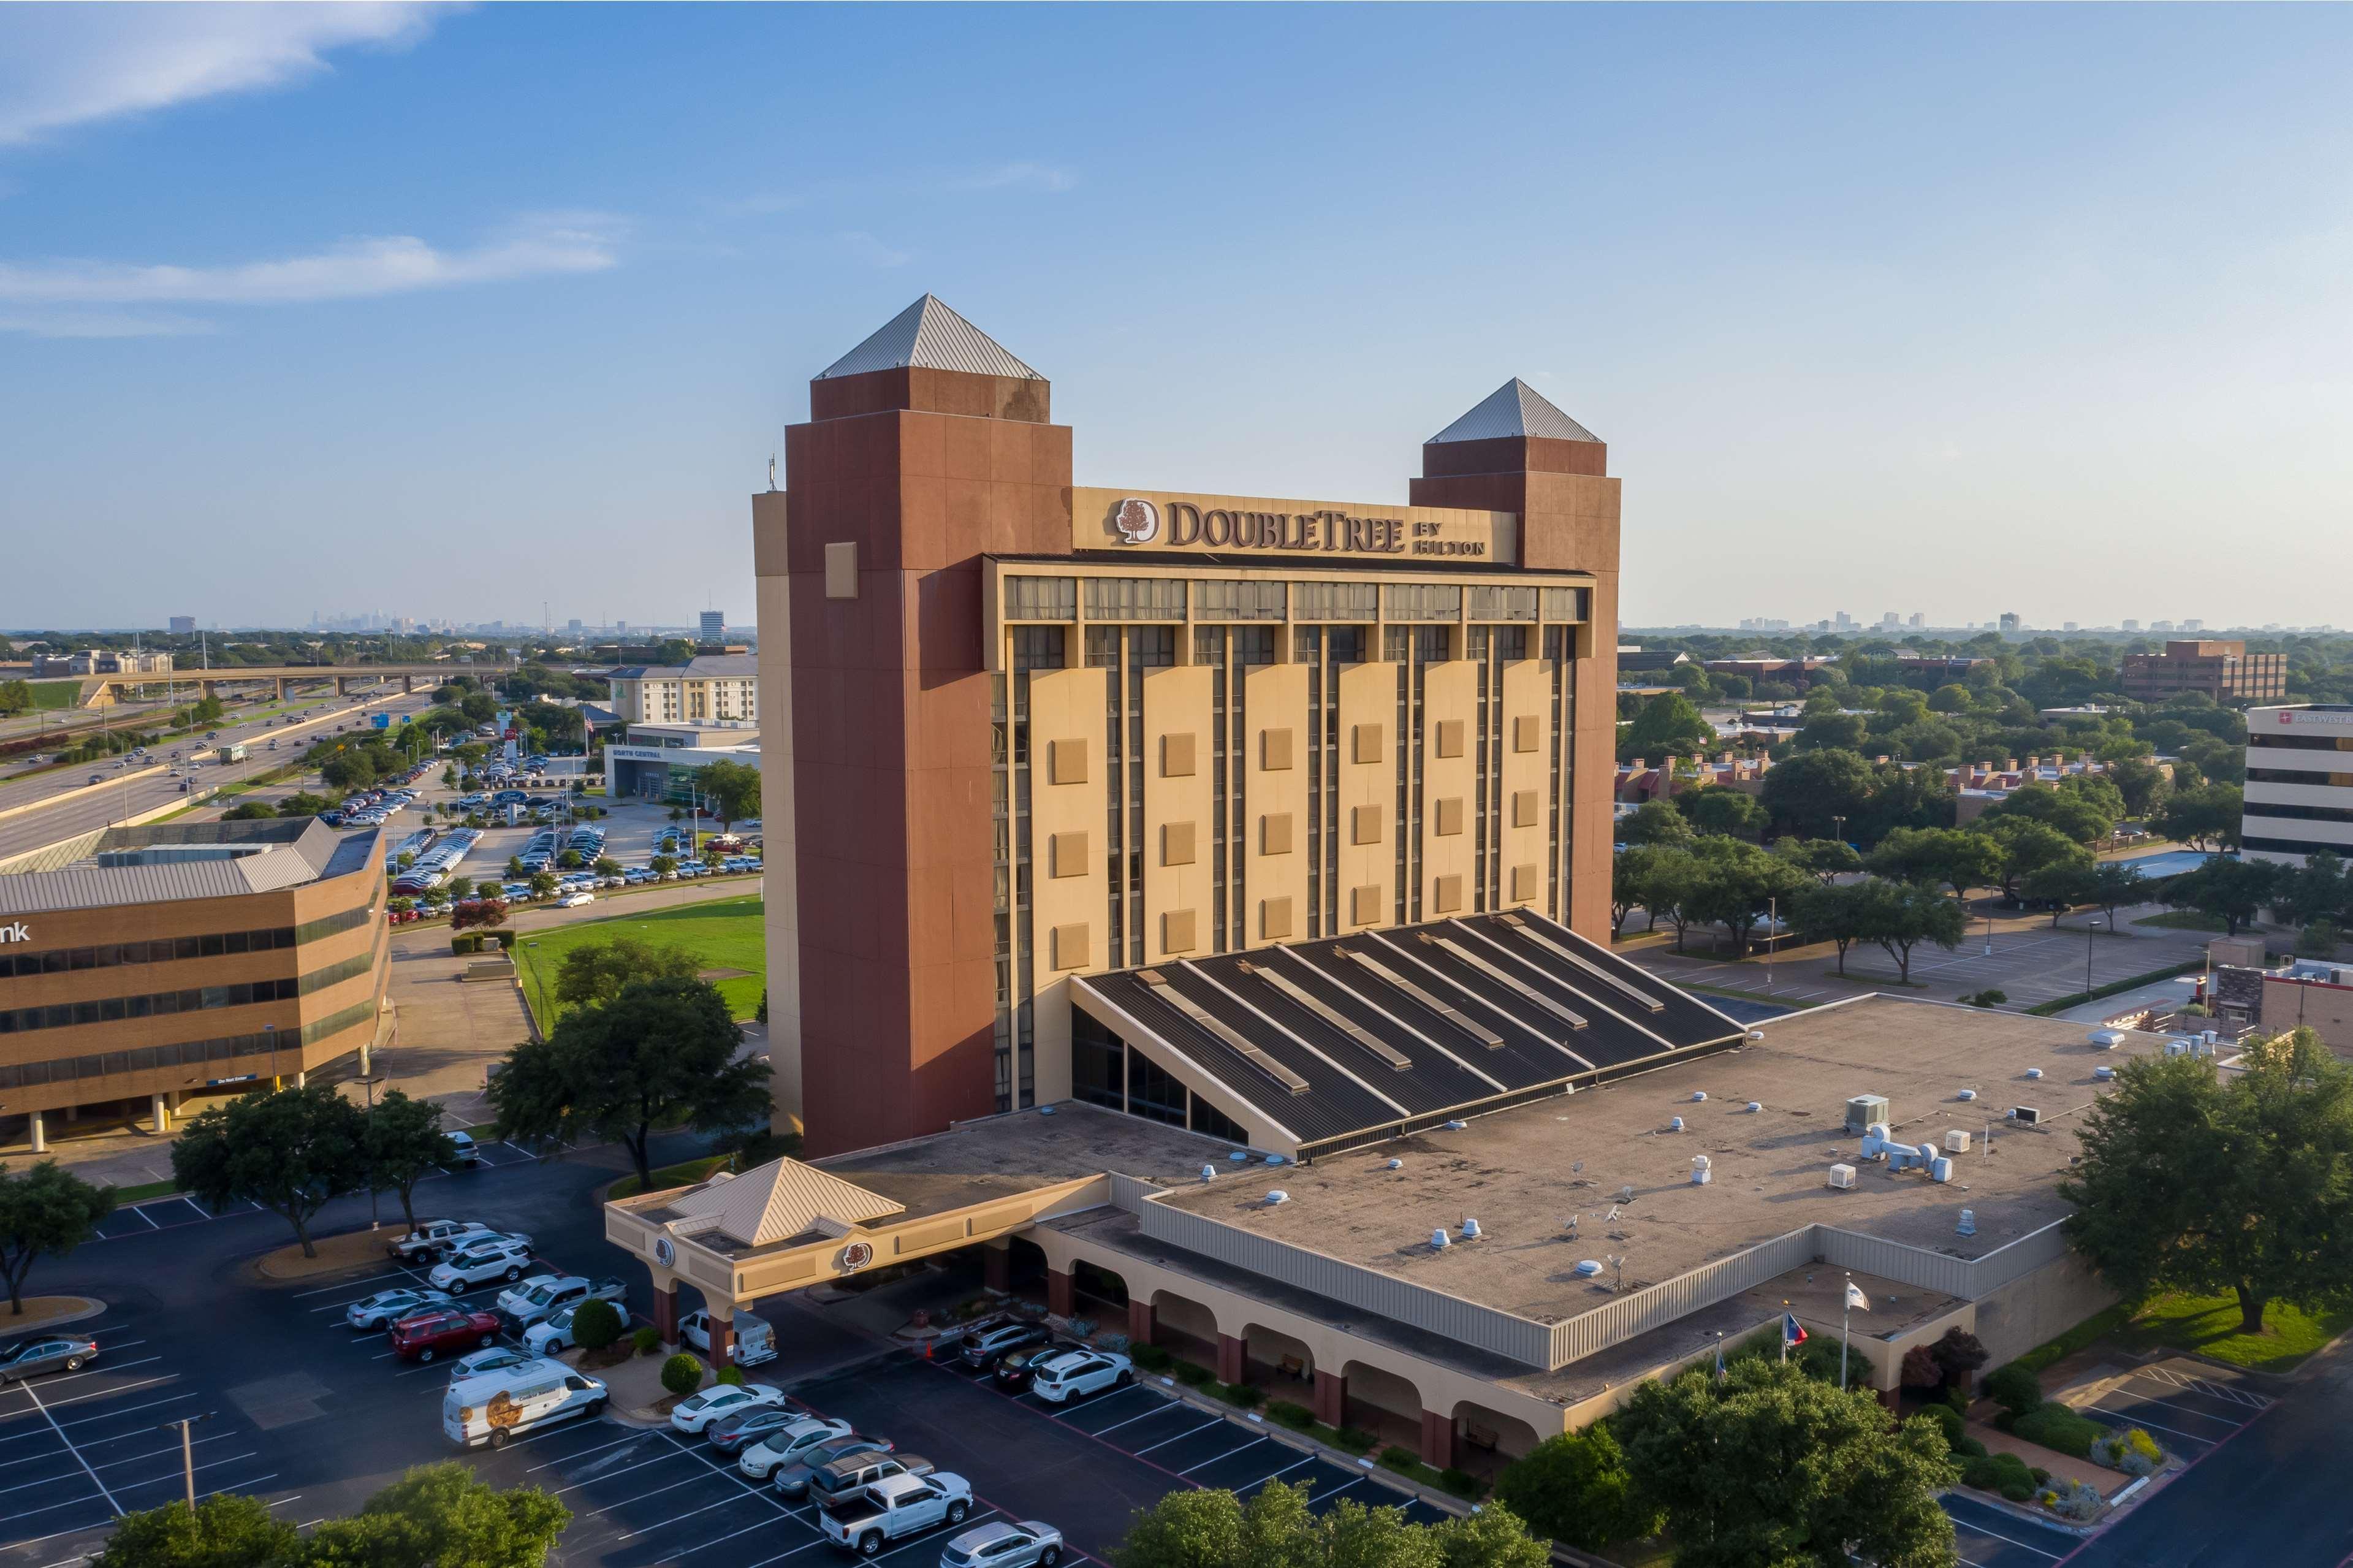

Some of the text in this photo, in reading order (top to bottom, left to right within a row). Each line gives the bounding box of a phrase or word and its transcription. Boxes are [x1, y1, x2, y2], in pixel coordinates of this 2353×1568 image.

[1419, 522, 1442, 536] BY
[1419, 541, 1485, 555] HILTON
[501, 793, 521, 801] Ford
